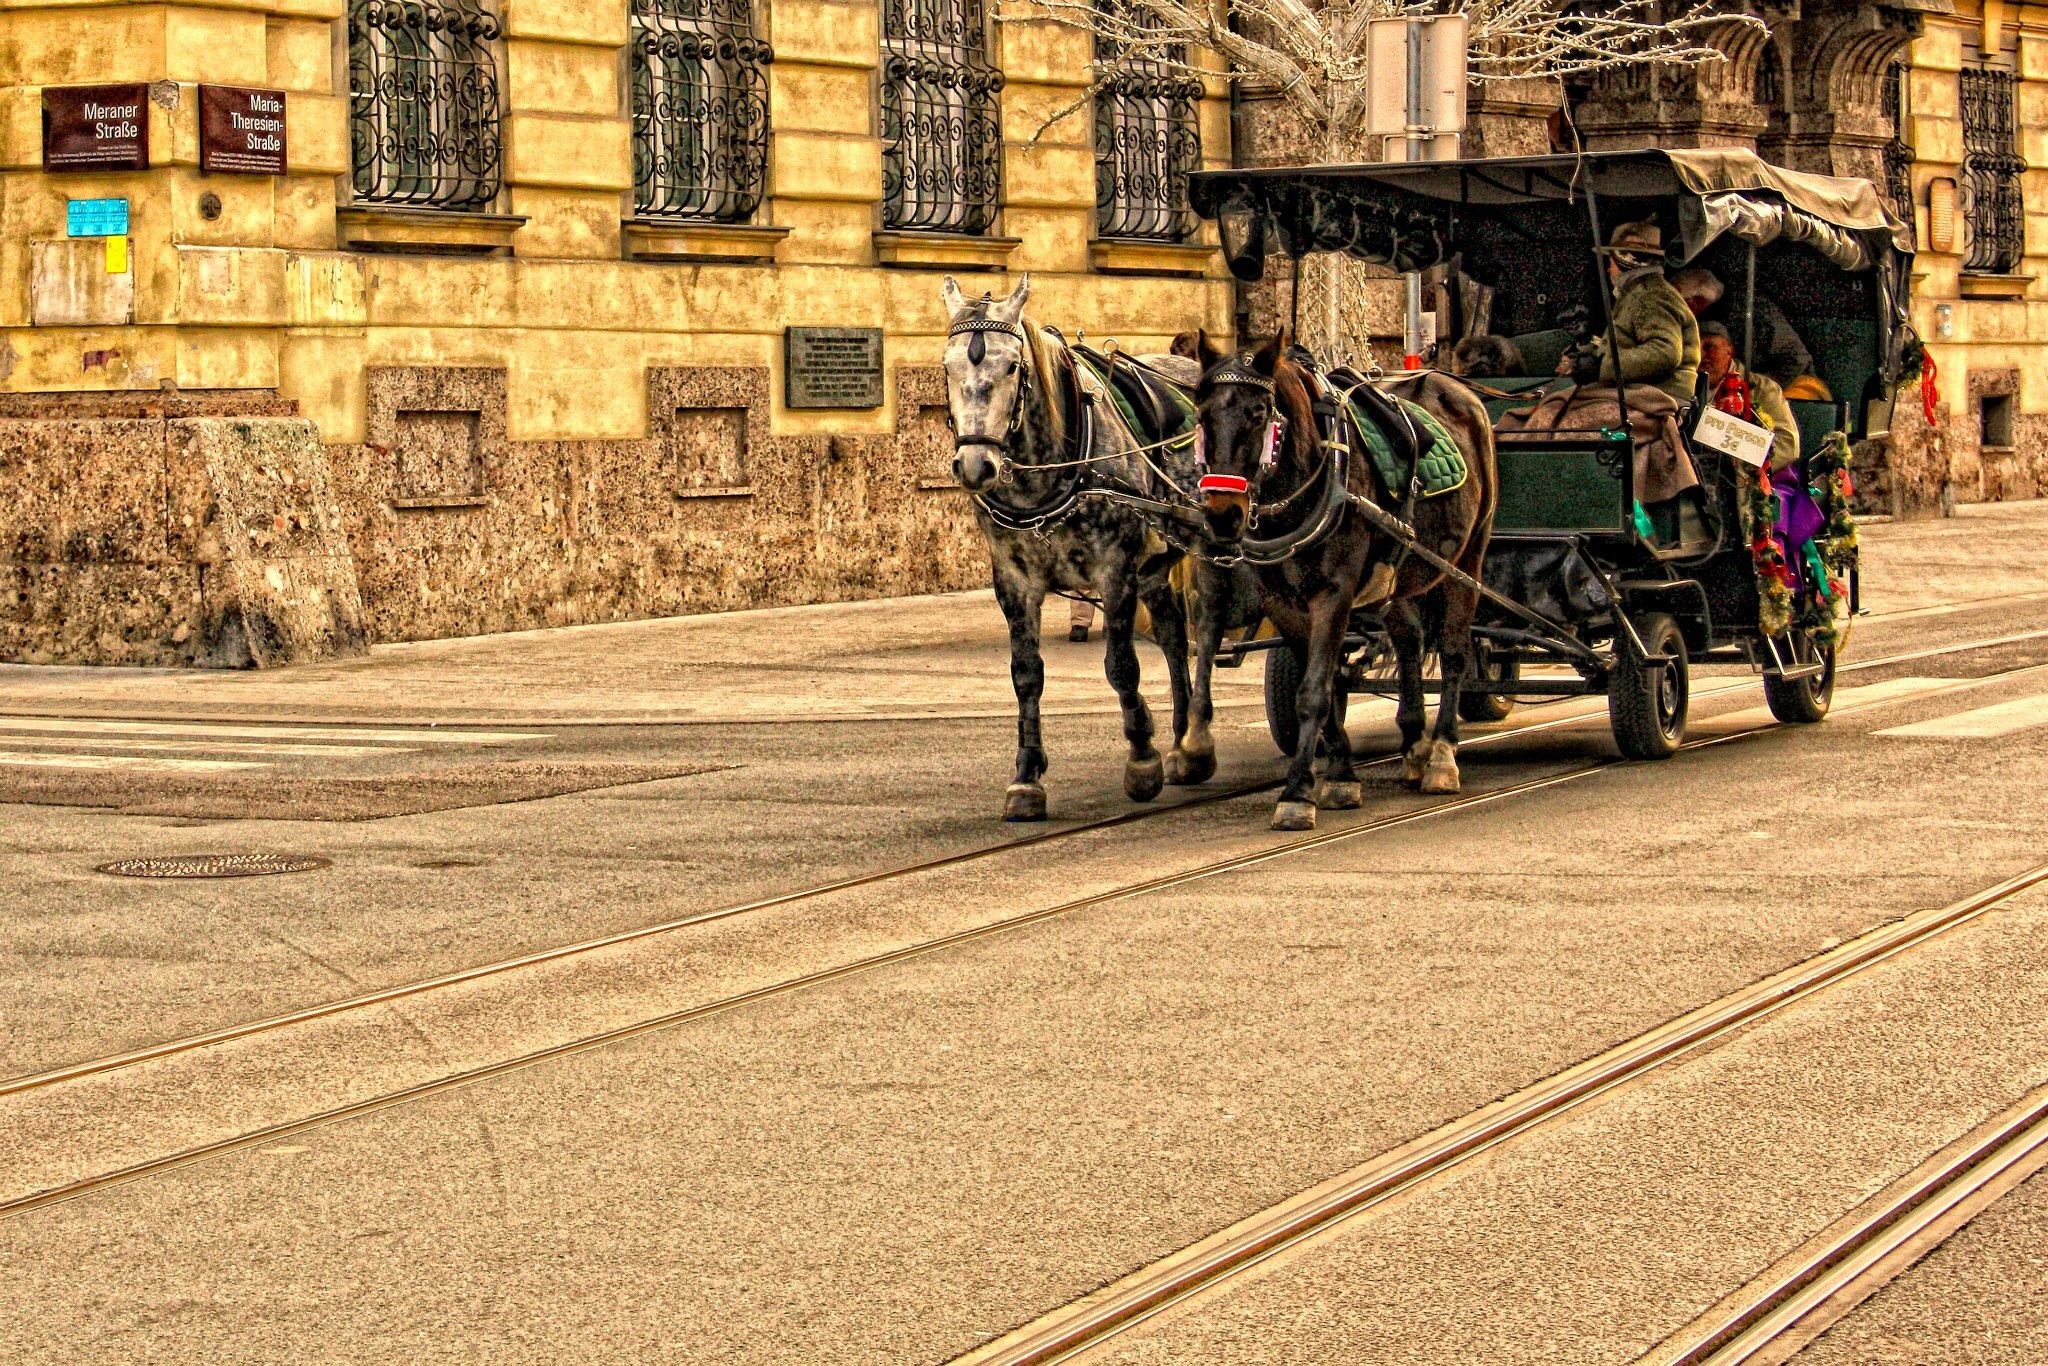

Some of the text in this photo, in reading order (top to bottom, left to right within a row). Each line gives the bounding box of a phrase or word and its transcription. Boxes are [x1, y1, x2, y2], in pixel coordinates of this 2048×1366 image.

[84, 103, 138, 120] Meraner
[250, 94, 283, 112] Maria-
[96, 121, 138, 139] Straße
[231, 112, 284, 132] Theresien-
[247, 133, 281, 151] Straße
[1726, 422, 1766, 448] Person
